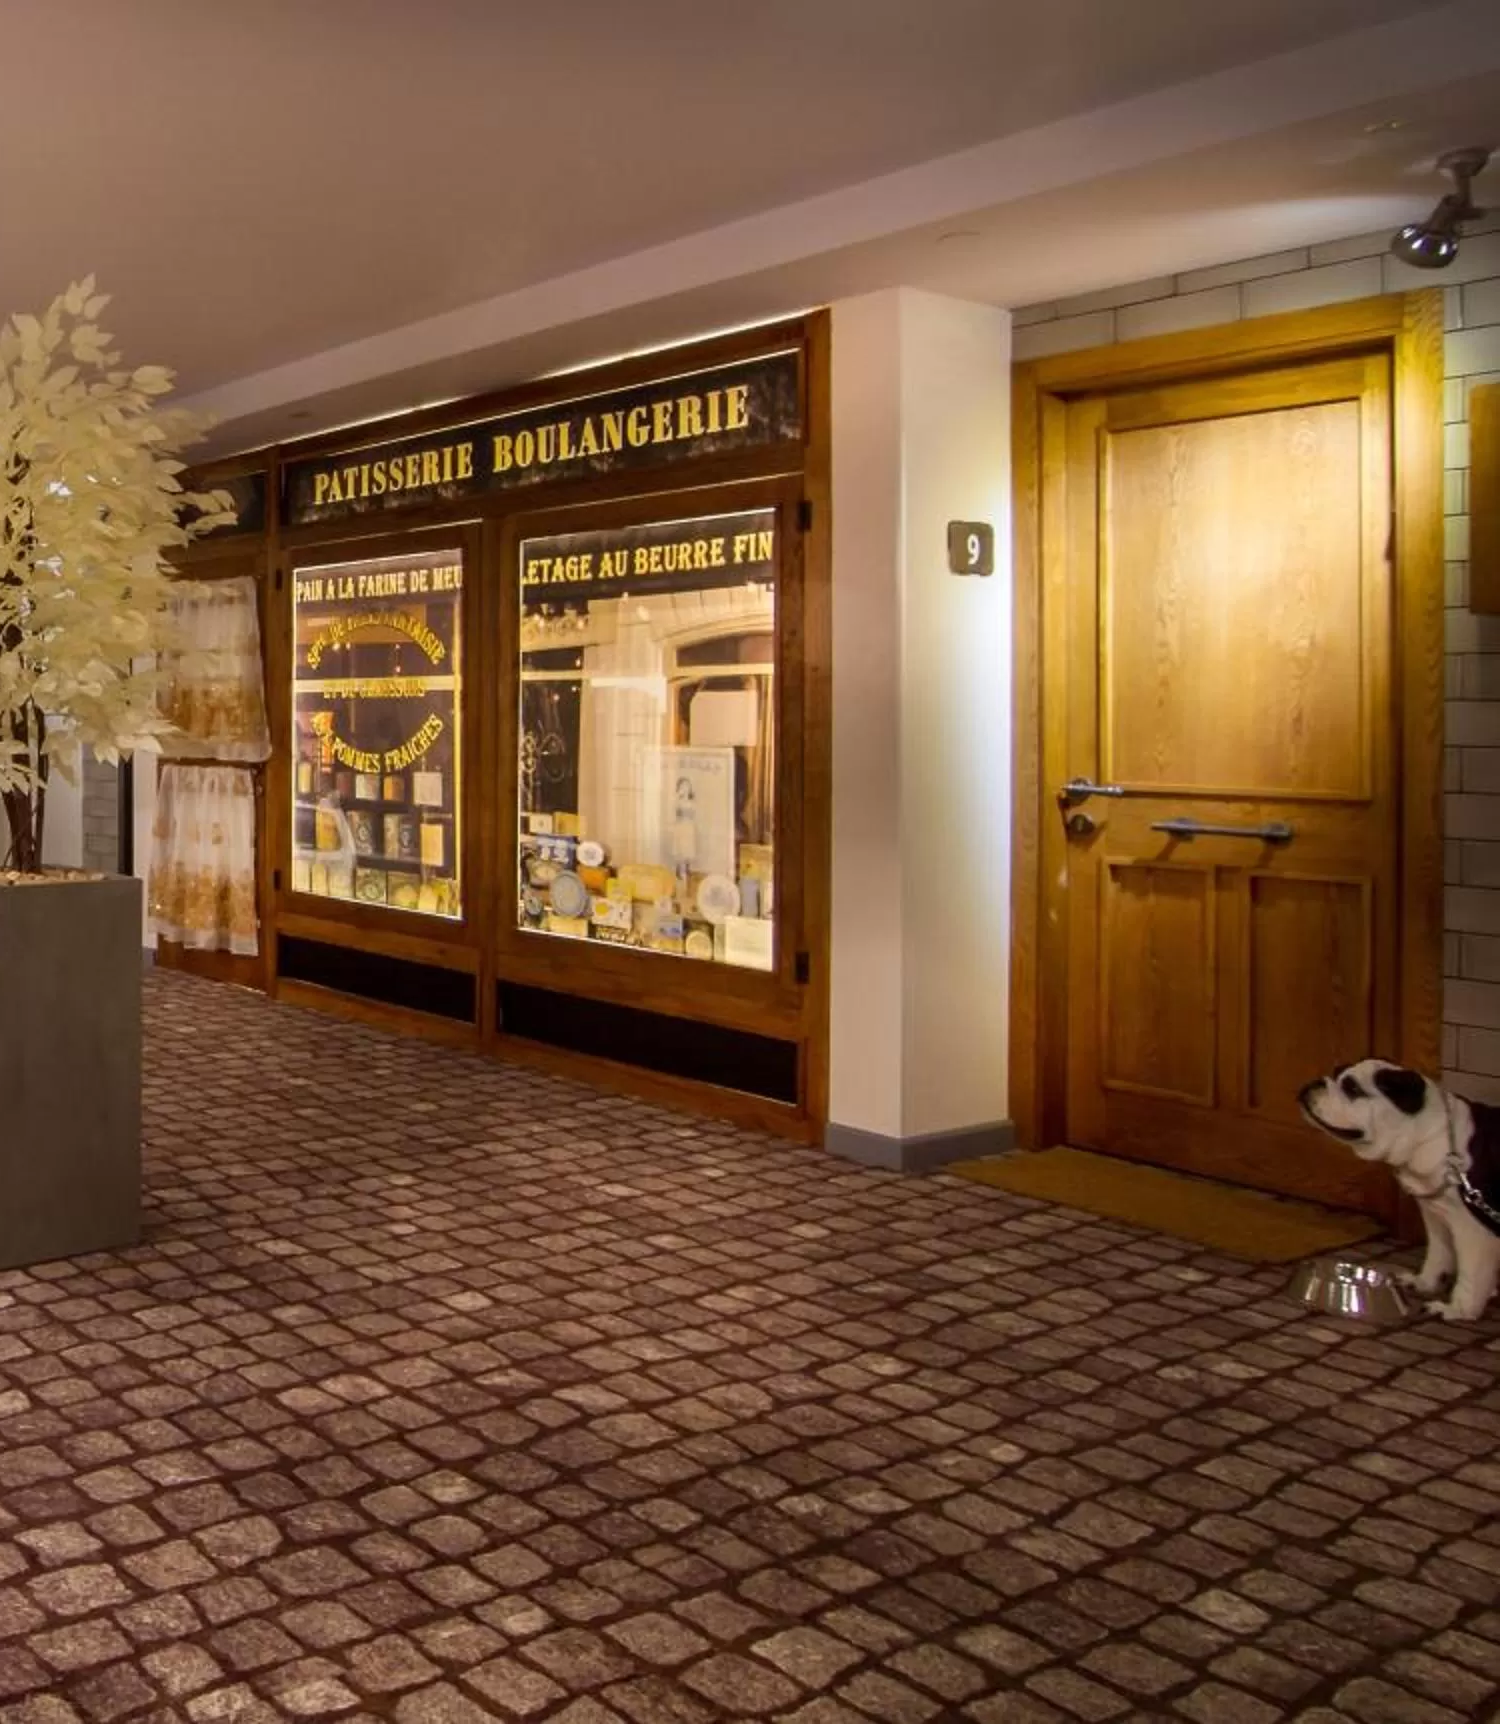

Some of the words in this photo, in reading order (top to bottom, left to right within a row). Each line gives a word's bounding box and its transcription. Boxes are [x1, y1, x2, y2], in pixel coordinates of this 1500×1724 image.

[314, 442, 473, 506] PATISSERIE
[492, 384, 749, 473] BOULANGERIE
[521, 554, 593, 585] ETAGE
[599, 551, 629, 579] AU
[634, 537, 725, 575] BEURRE
[733, 531, 774, 565] FIN
[967, 533, 980, 566] 9
[296, 578, 323, 602] PAIN
[338, 577, 354, 599] LA
[358, 571, 406, 598] FARINE
[410, 569, 429, 593] DE
